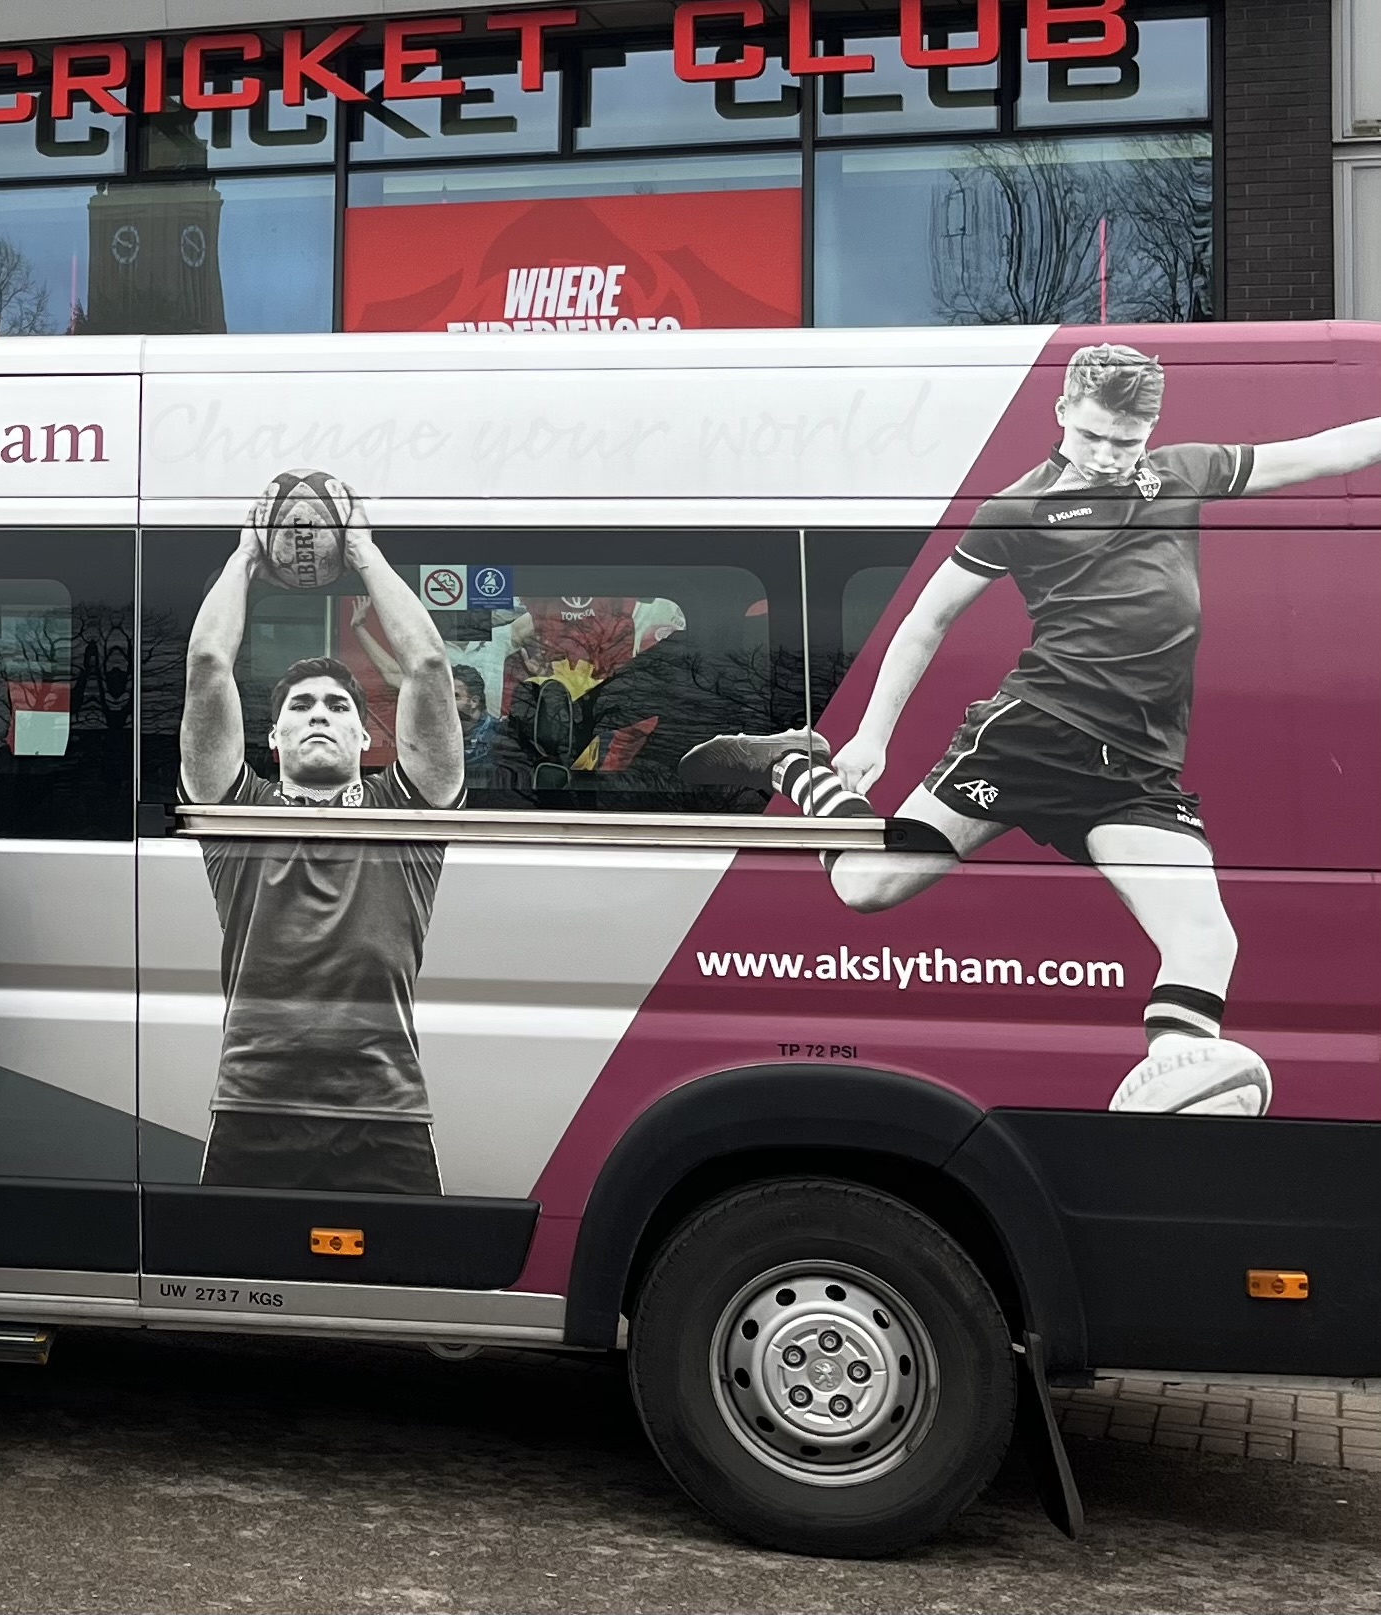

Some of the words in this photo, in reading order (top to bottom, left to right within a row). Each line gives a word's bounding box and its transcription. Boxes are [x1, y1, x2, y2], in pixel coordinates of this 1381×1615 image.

[503, 264, 626, 319] WHERE
[147, 398, 451, 480] Change
[469, 418, 671, 482] your
[699, 388, 941, 461] world
[696, 946, 1125, 990] www.akslytham.com
[777, 1043, 801, 1057] TP
[805, 1044, 825, 1058] 72
[829, 1044, 858, 1059] PSI
[159, 1283, 187, 1298] UW
[195, 1287, 240, 1302] 2737
[248, 1290, 284, 1307] KGS
